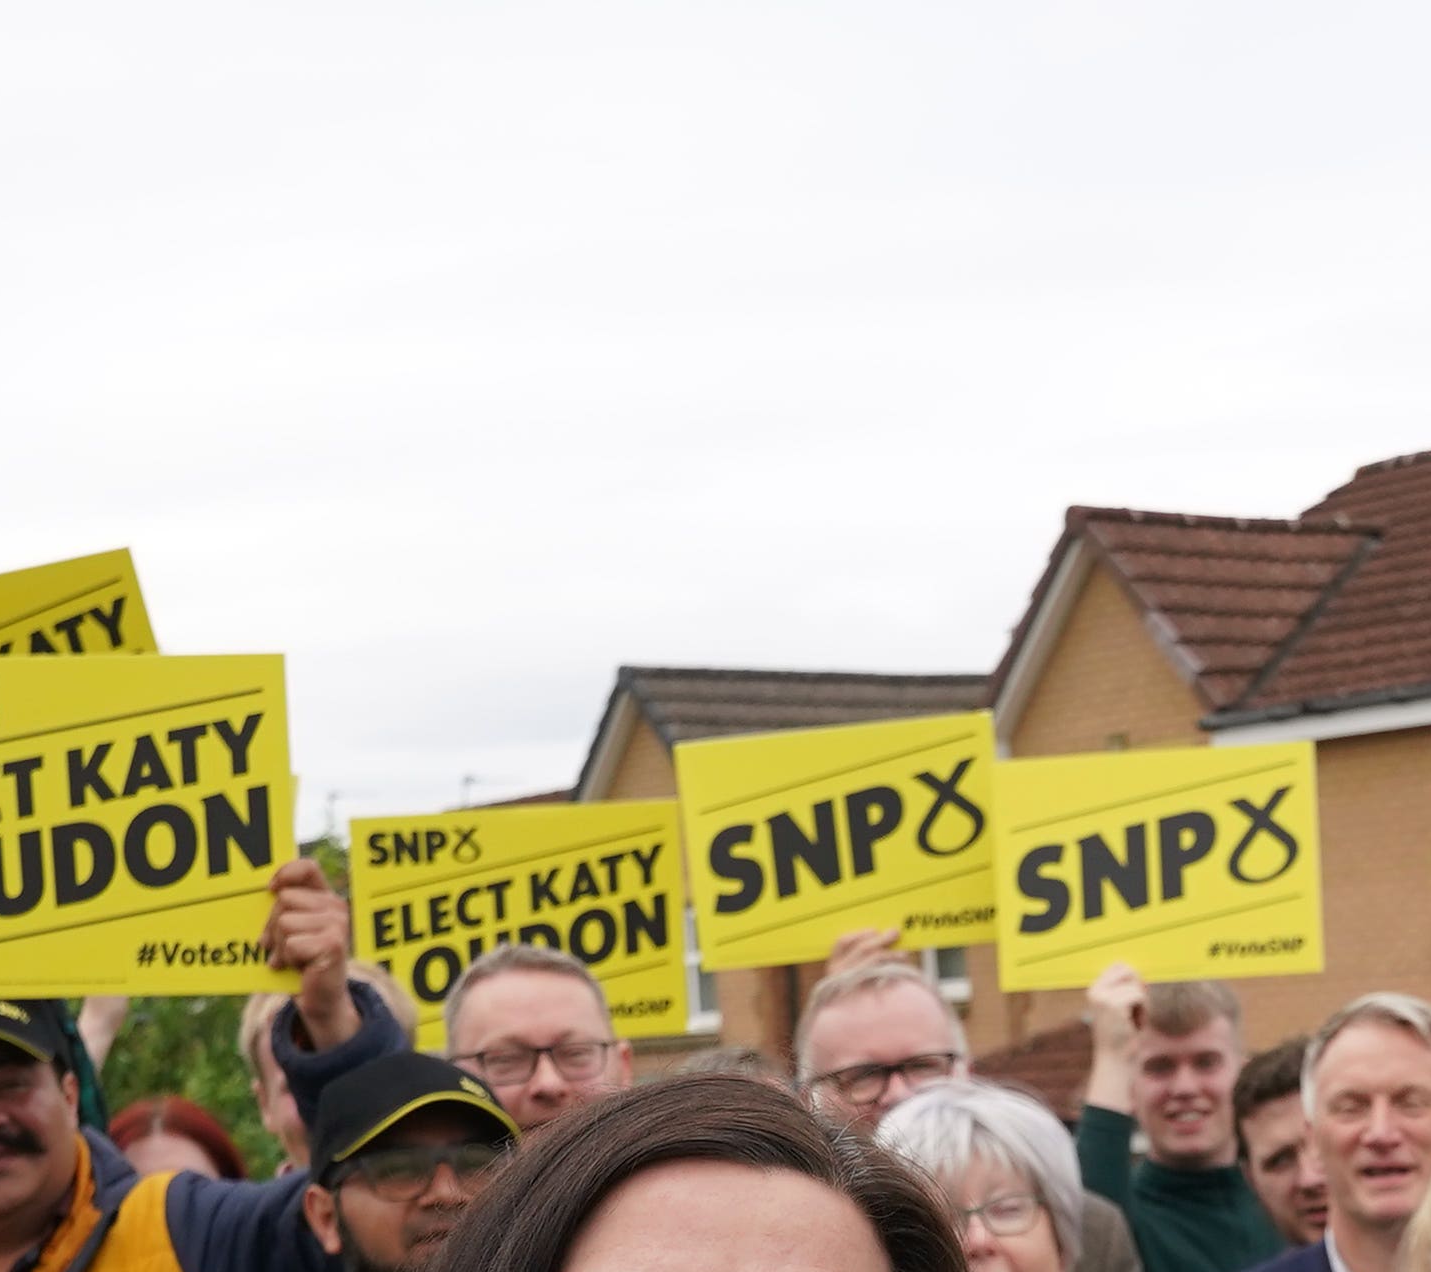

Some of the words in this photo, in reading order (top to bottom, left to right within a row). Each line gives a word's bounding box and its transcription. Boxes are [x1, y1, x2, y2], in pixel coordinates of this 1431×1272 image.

[66, 711, 264, 809] KATY
[367, 830, 446, 868] SNP
[373, 878, 513, 952] ELECT
[529, 843, 664, 915] KATY
[708, 785, 903, 915] SNP
[1016, 806, 1219, 935] SNP
[136, 940, 271, 968] #VoteSN
